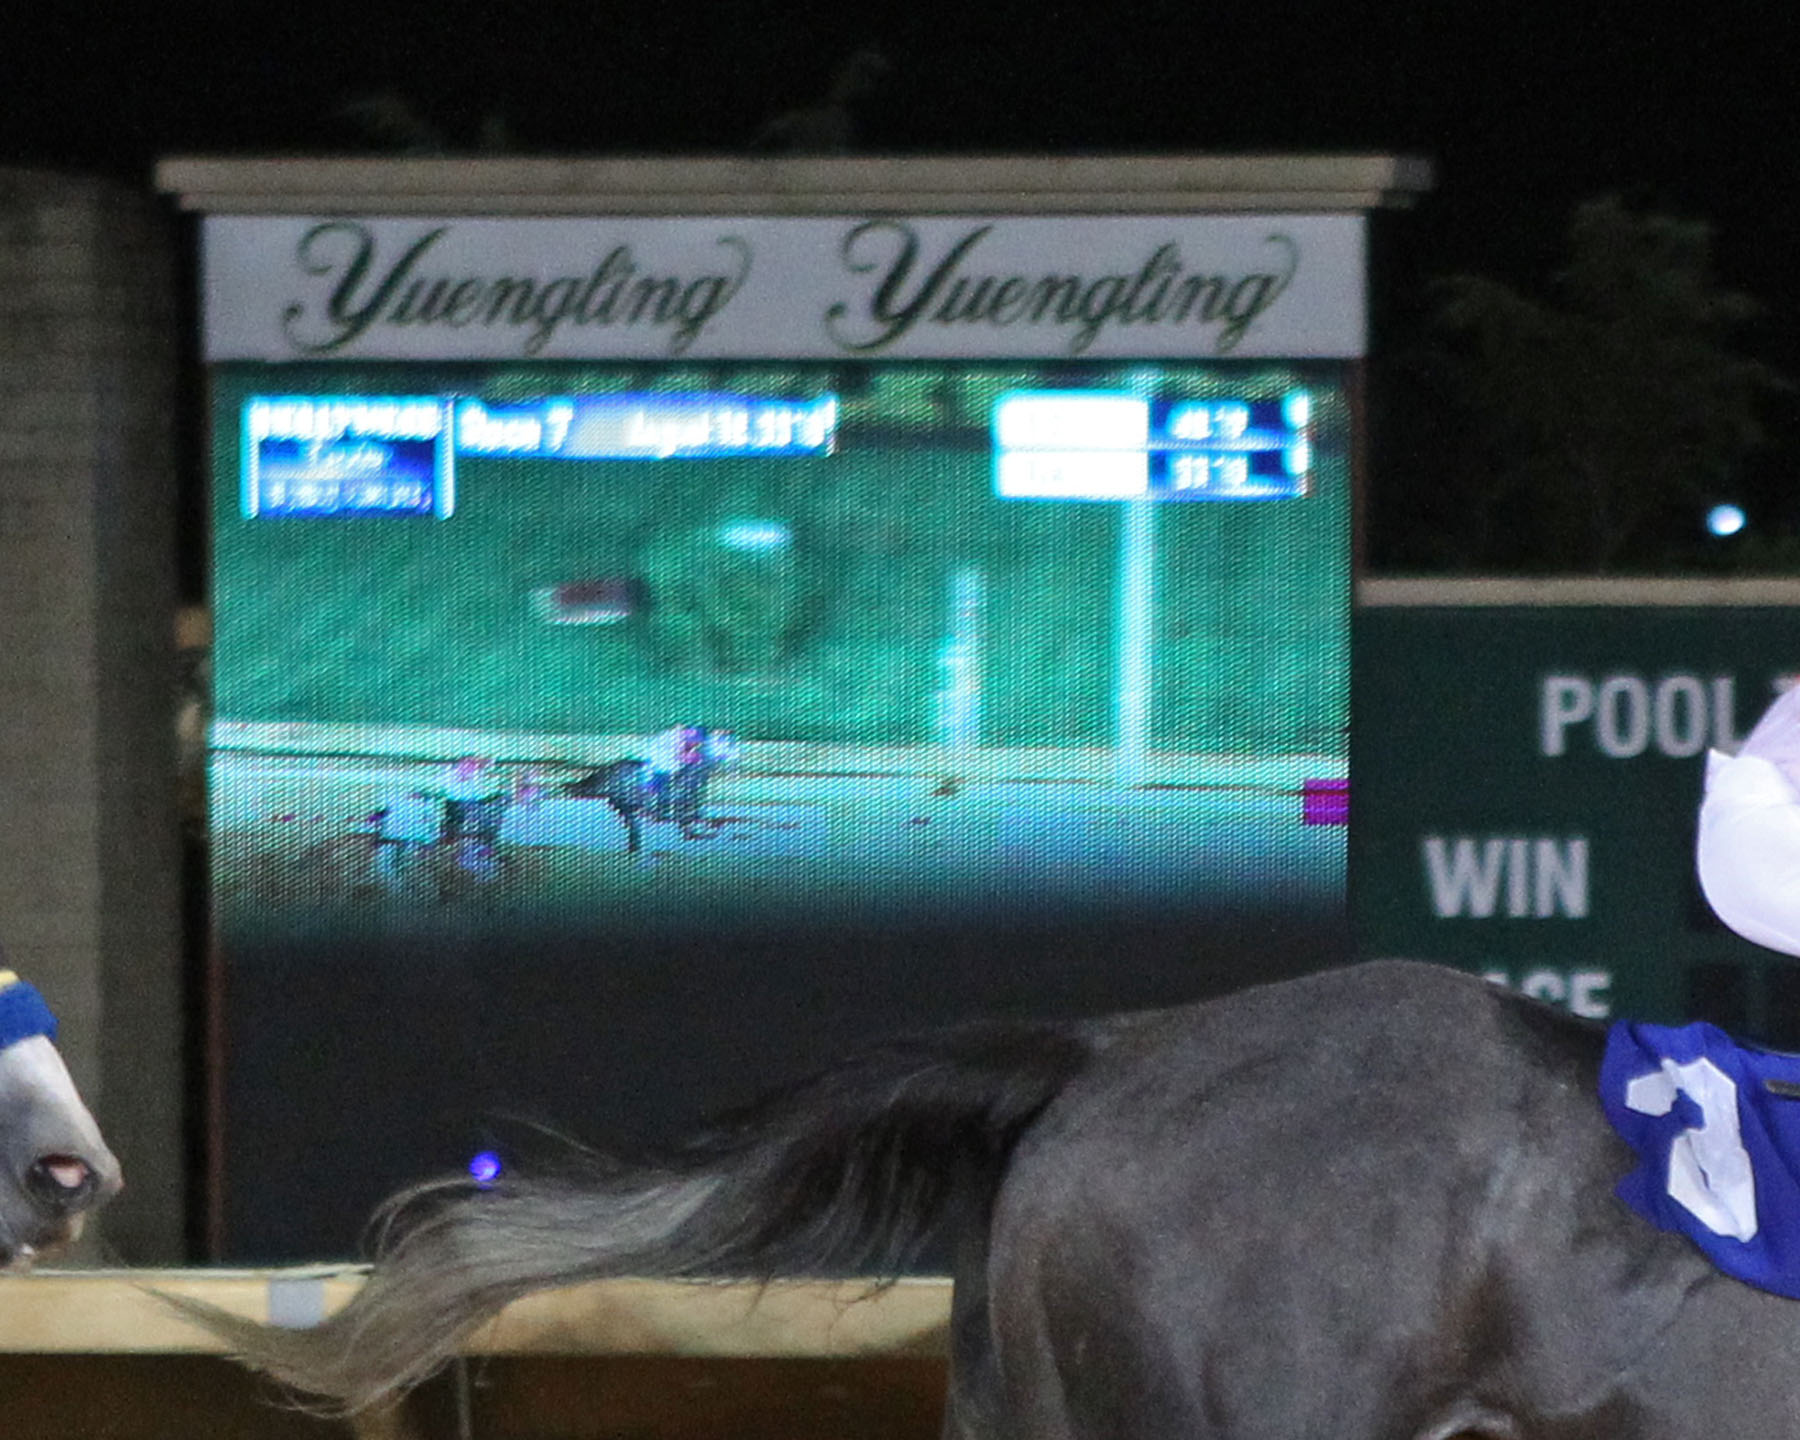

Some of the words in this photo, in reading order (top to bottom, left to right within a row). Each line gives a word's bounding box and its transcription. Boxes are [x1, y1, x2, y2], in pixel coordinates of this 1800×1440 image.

[280, 220, 755, 354] Yuengling
[824, 218, 1298, 354] Yuengling
[1540, 674, 1748, 758] POOL
[1422, 839, 1589, 918] WIN
